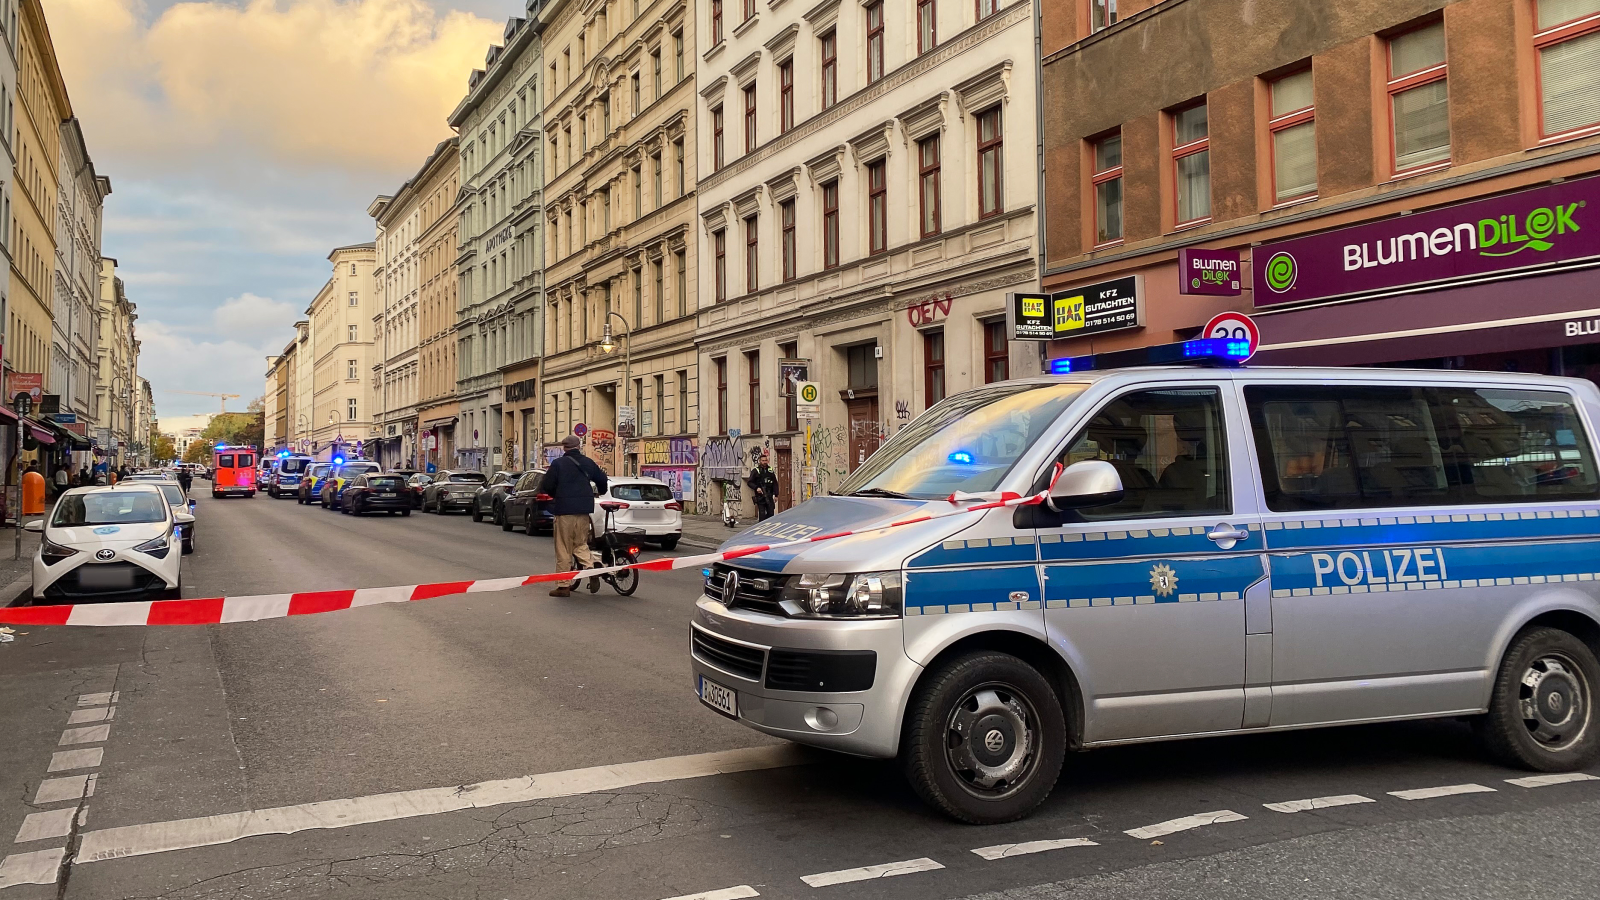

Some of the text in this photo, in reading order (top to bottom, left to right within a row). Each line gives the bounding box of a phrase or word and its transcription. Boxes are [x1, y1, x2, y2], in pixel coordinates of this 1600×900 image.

[486, 226, 512, 254] APOTHEKE
[1100, 289, 1117, 299] KFZ
[1024, 302, 1042, 312] HAK
[1086, 297, 1134, 312] GUTACHTEN
[1057, 303, 1082, 325] HAK
[1086, 319, 1101, 327] 0178
[1103, 316, 1115, 324] 514
[744, 522, 823, 541] POLIZEI
[1311, 548, 1447, 586] POLIZEI
